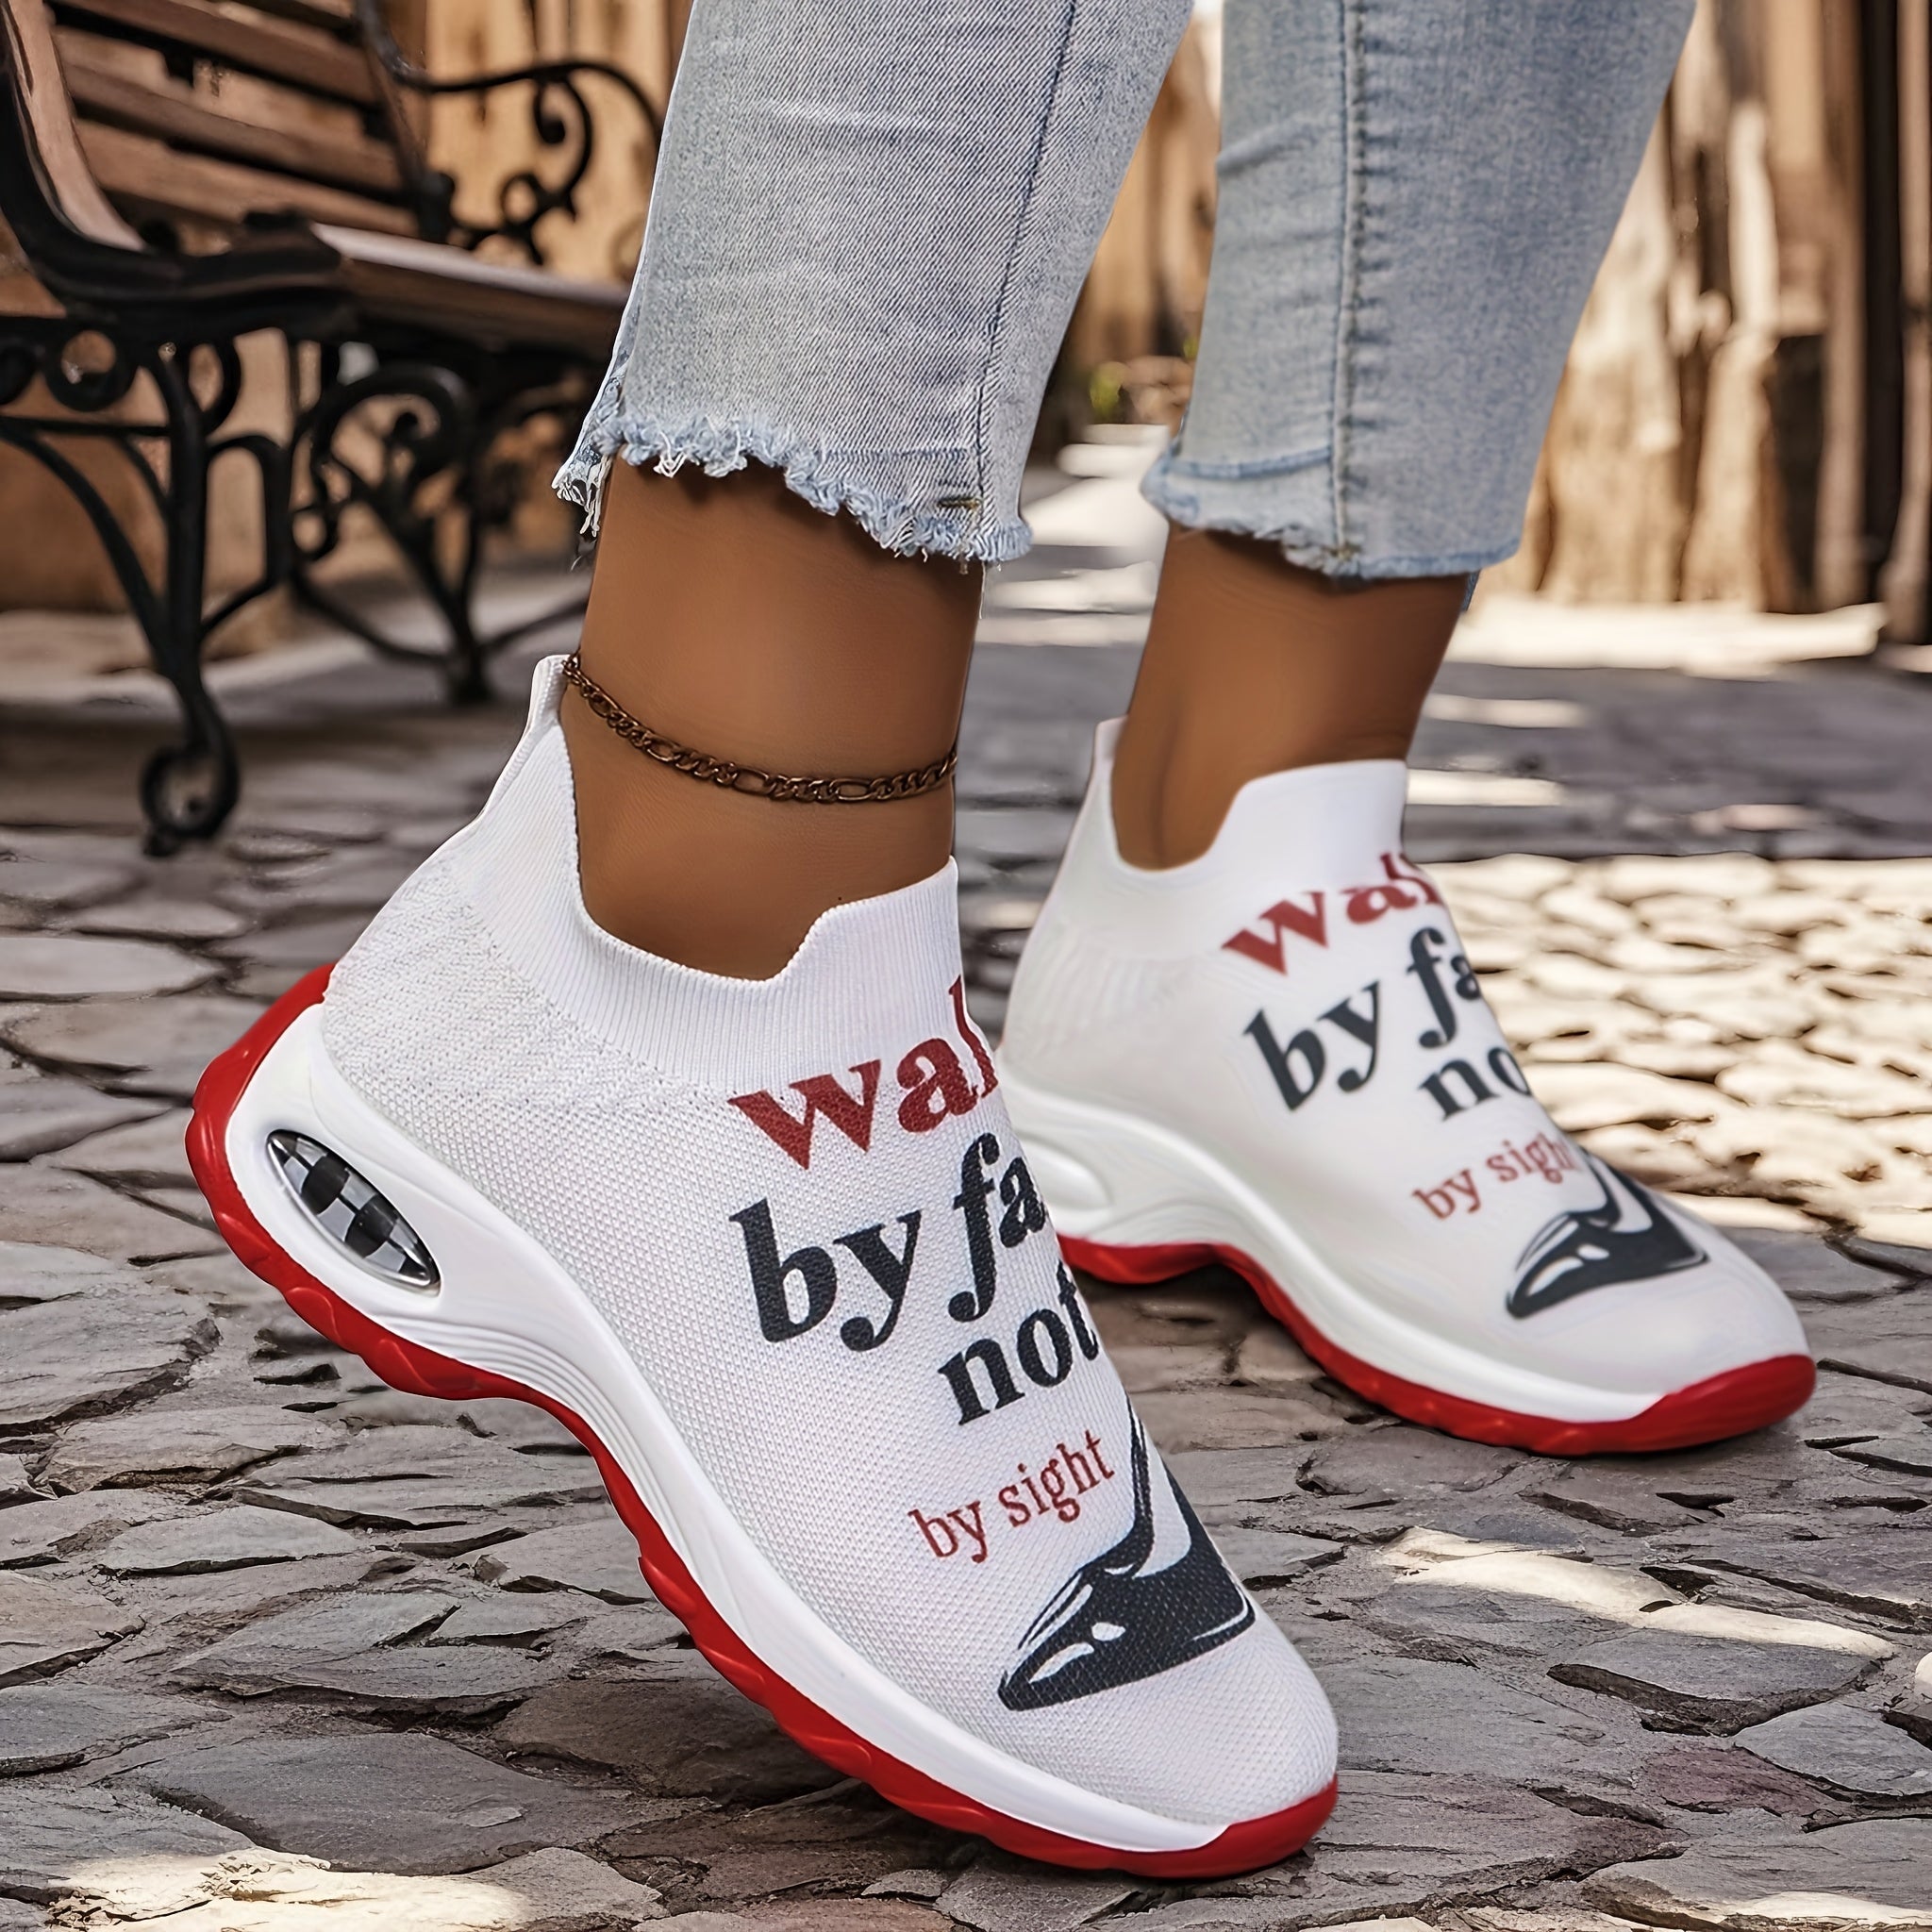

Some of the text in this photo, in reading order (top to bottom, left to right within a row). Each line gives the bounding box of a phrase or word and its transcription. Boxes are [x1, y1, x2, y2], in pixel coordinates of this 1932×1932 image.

[1242, 979, 1380, 1112] by
[729, 1133, 1046, 1352] by fa
[1412, 1168, 1482, 1220] by
[938, 1259, 1099, 1425] not
[908, 1429, 1115, 1563] by sight
